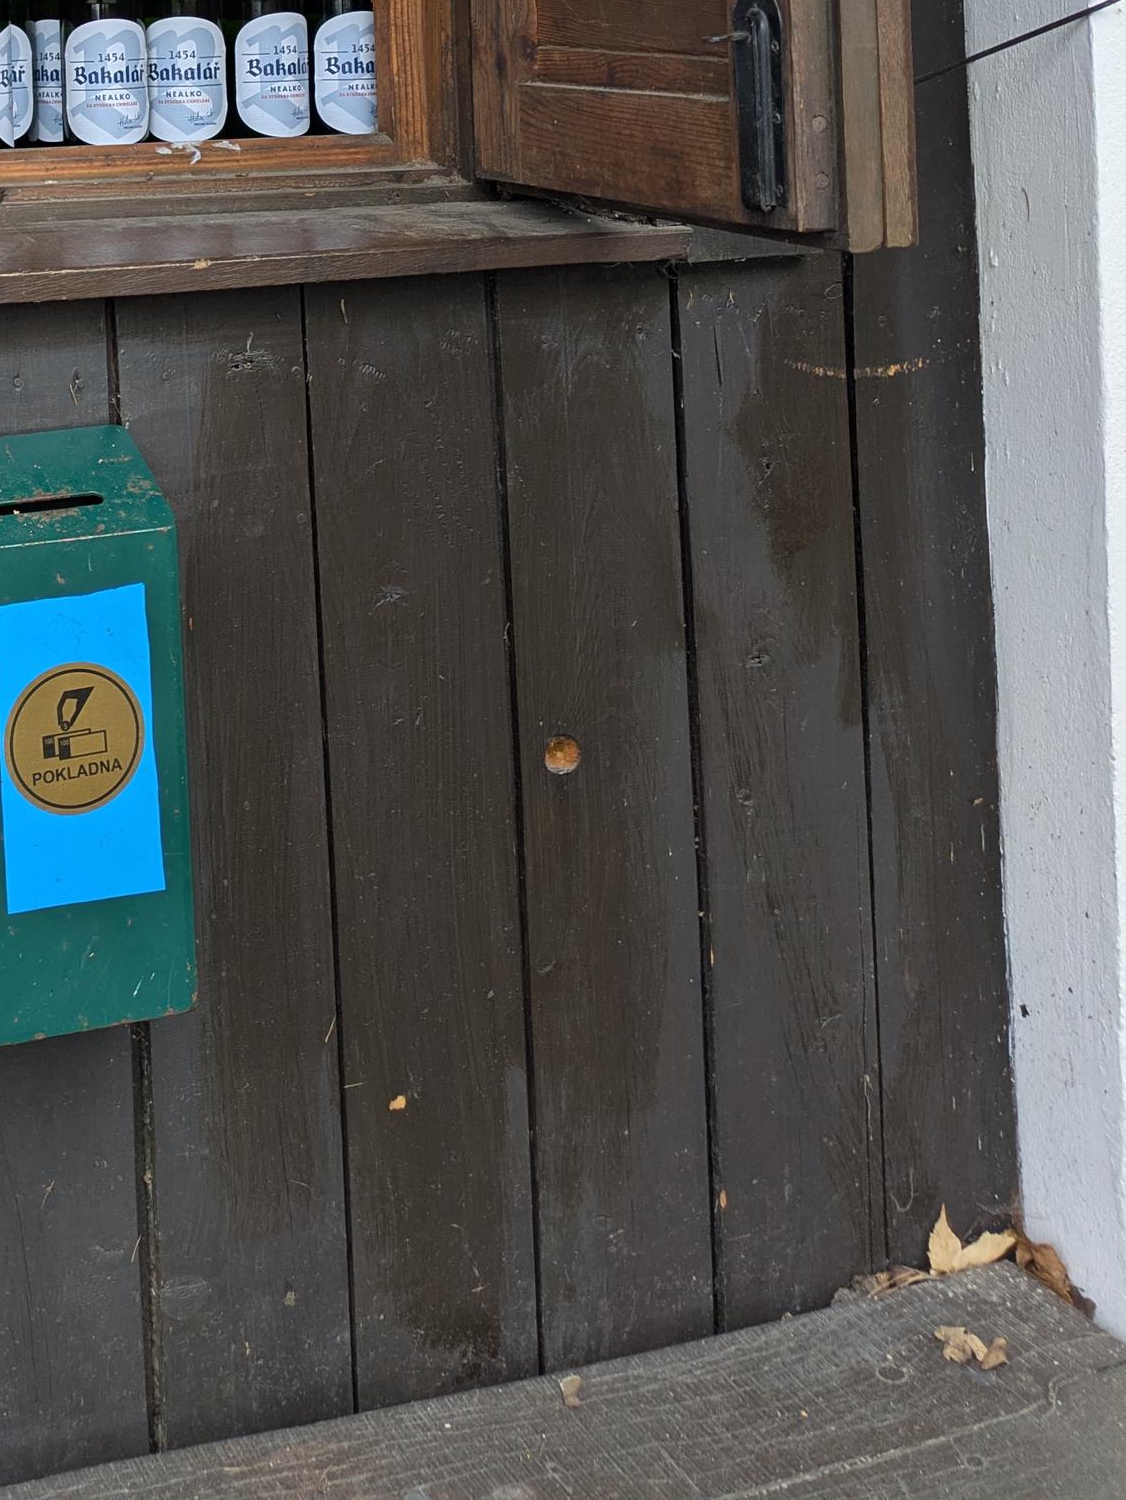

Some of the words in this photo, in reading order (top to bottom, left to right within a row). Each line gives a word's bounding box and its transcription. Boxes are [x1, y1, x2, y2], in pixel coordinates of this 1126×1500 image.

[273, 45, 298, 55] 1454
[351, 43, 376, 53] 1454
[97, 52, 125, 63] 1454
[169, 50, 196, 60] 1454
[245, 58, 307, 77] Bakalá
[323, 56, 375, 75] Baka
[73, 64, 145, 86] Bakalář
[147, 61, 221, 82] Bakalář
[270, 85, 302, 93] NEALKO
[348, 83, 377, 91] NEALK
[95, 93, 131, 101] NEALKO
[165, 90, 202, 98] NEALKO
[32, 758, 123, 786] POKLADNA
